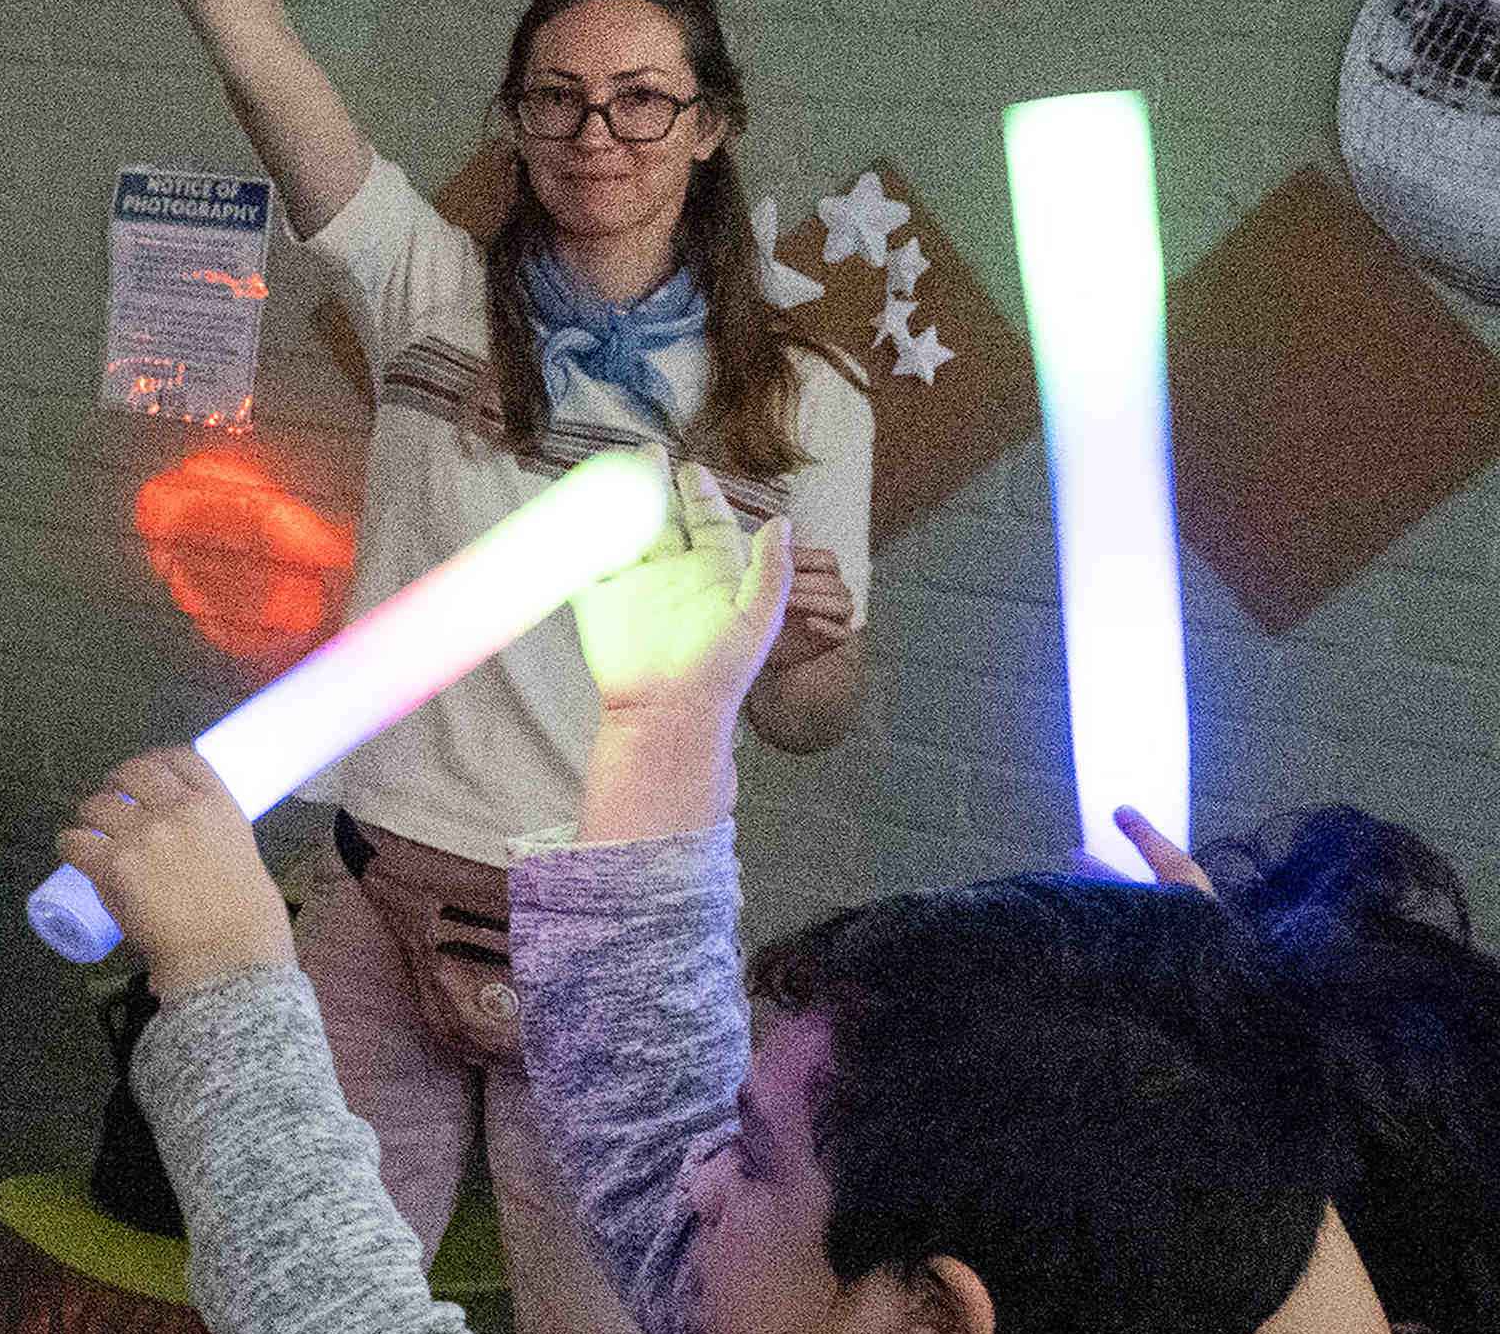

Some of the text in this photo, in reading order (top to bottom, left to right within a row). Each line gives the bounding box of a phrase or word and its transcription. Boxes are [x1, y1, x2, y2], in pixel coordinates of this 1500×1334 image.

[146, 176, 244, 201] NOTICE OF
[121, 194, 262, 223] PHOTOGRAPHY
